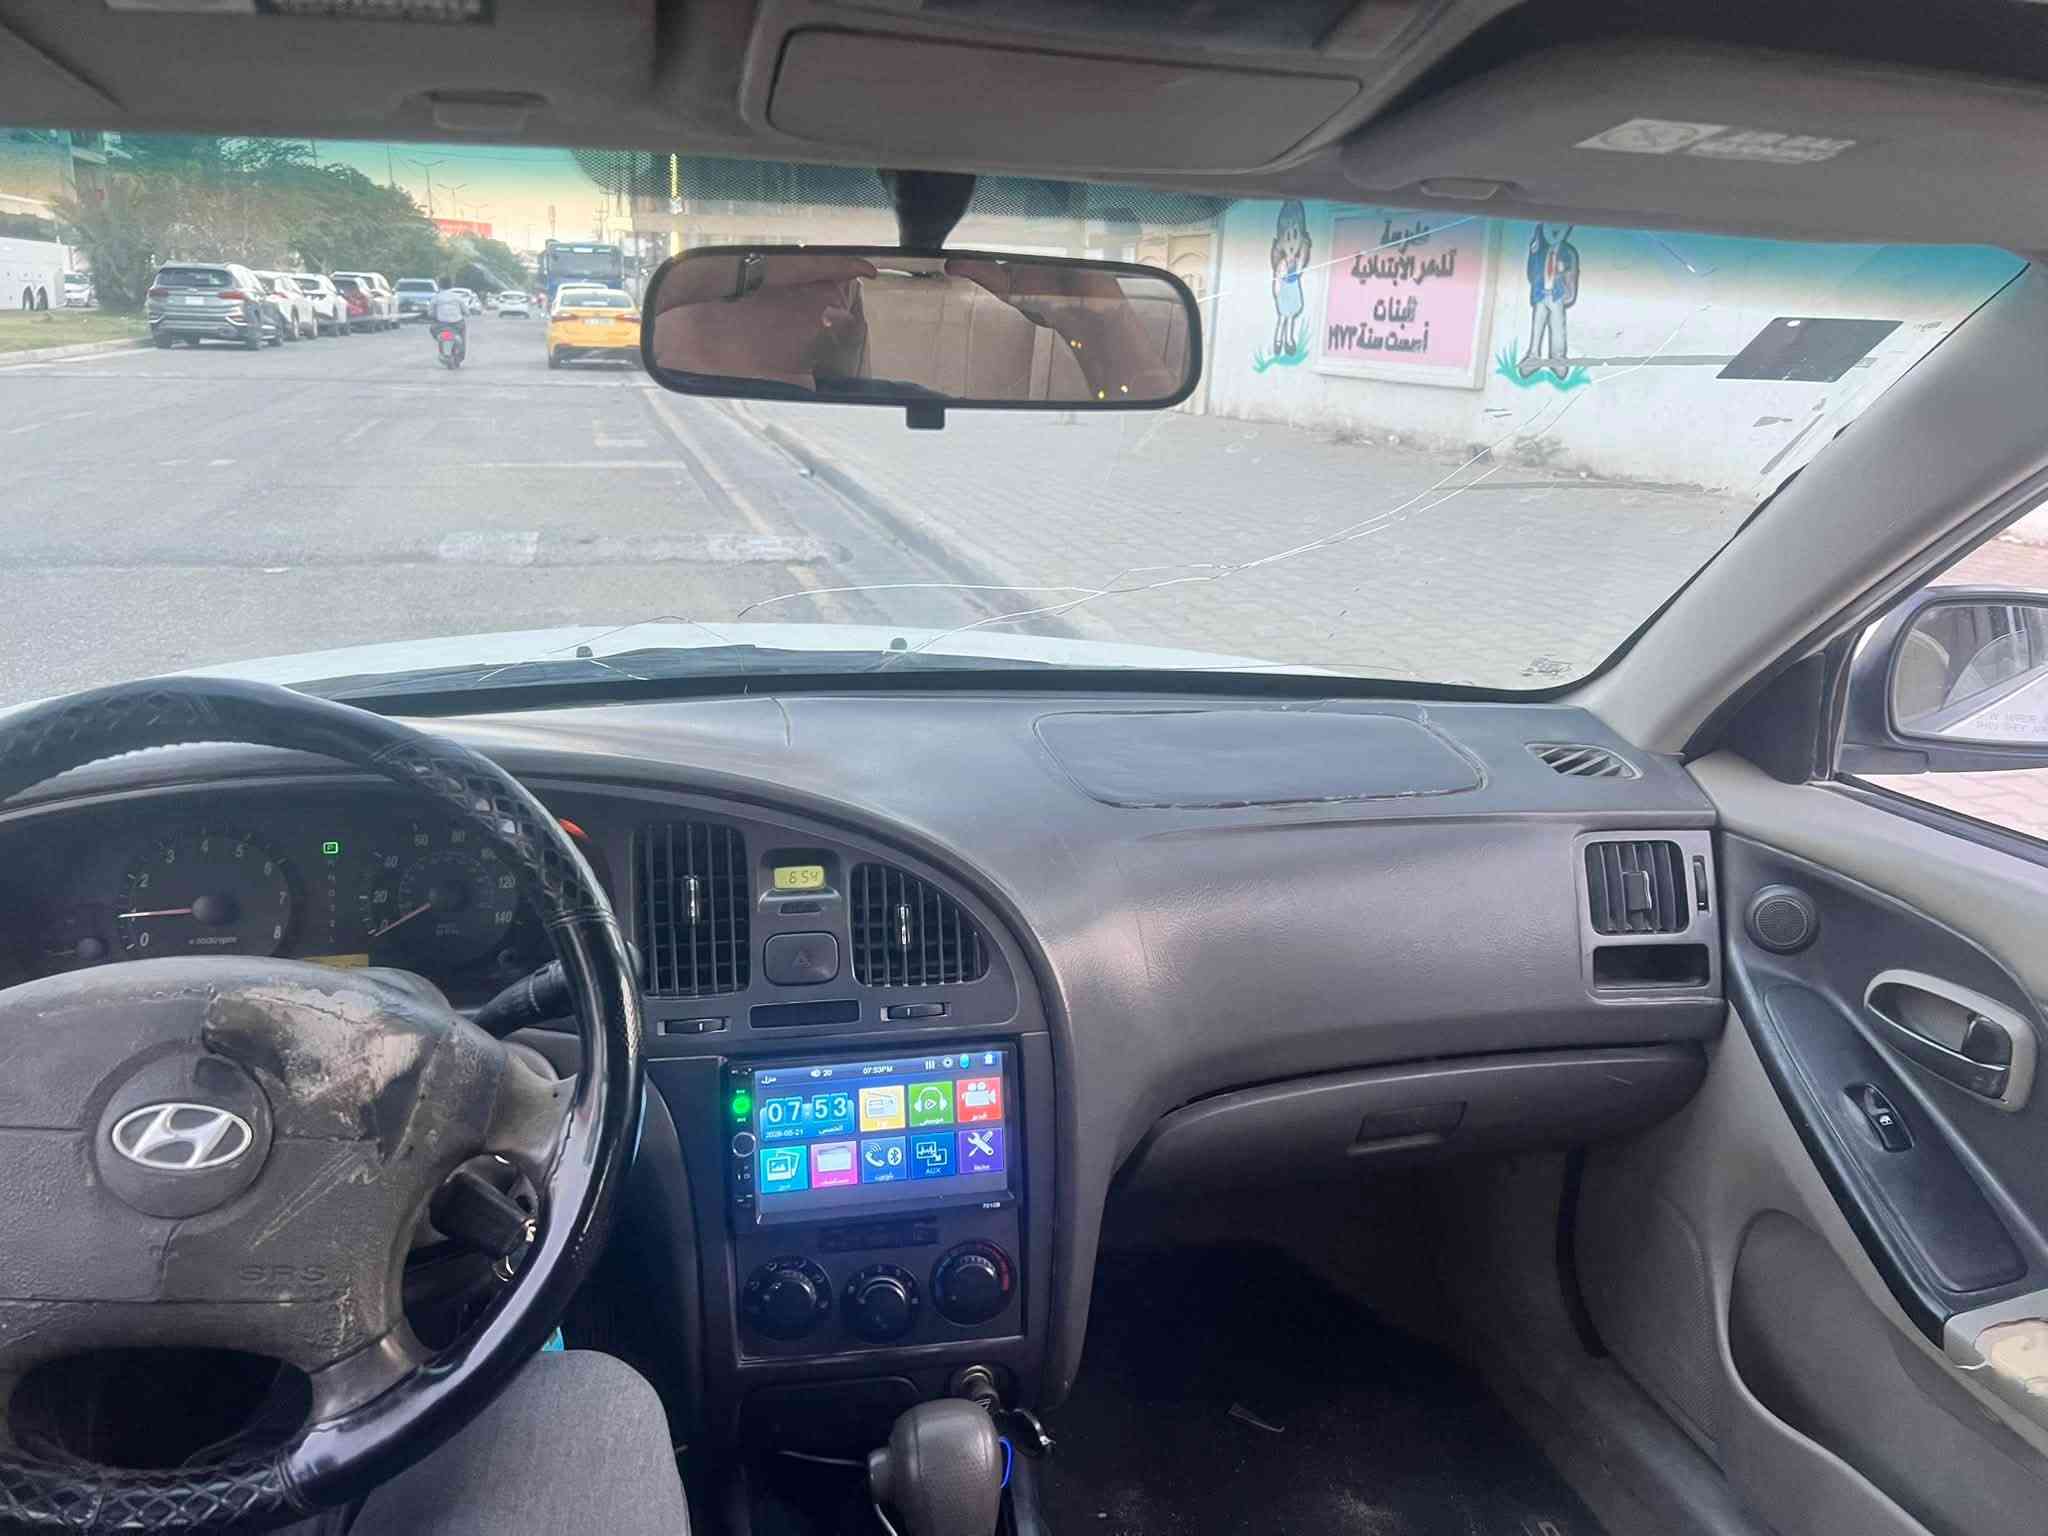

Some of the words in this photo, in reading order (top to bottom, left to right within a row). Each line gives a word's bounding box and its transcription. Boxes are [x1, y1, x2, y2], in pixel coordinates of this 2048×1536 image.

[165, 849, 175, 864] 3
[139, 873, 150, 888] 2
[373, 890, 388, 904] 20
[139, 932, 150, 947] 0
[273, 925, 282, 940] 8
[239, 1265, 329, 1282] SRS
